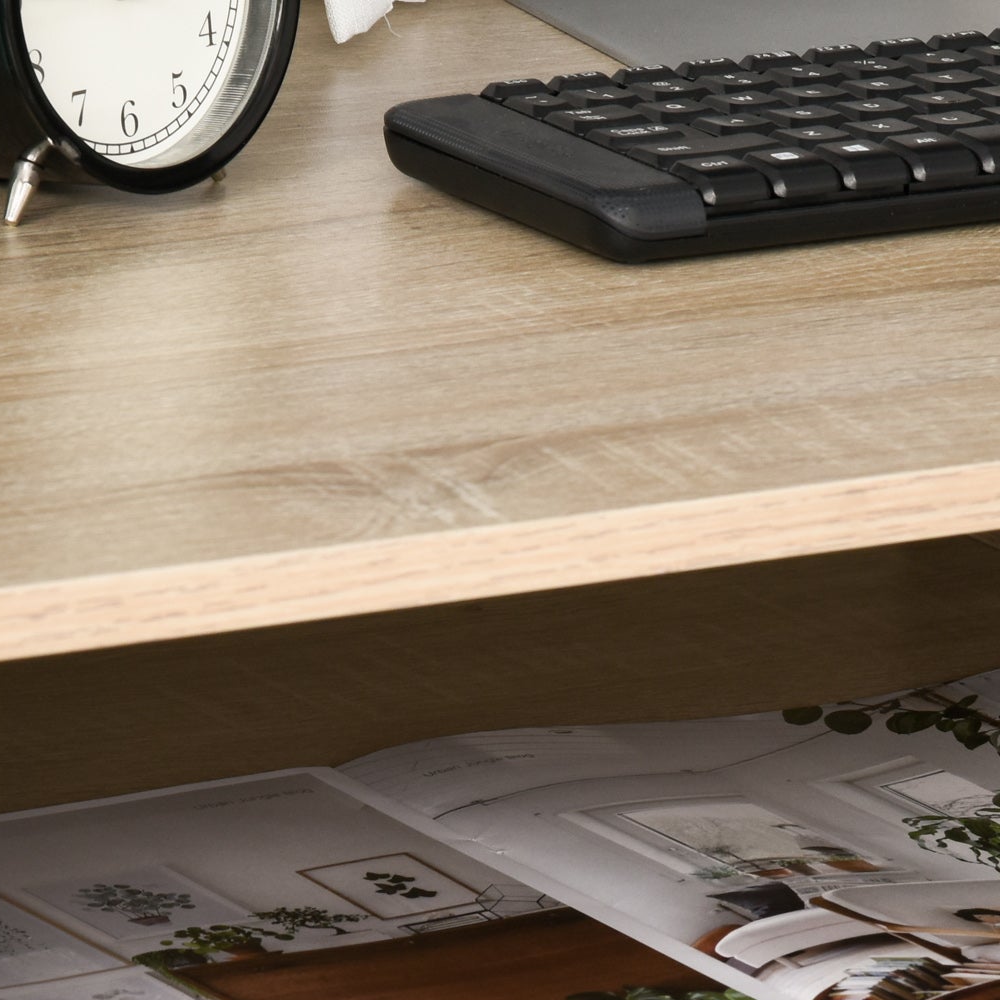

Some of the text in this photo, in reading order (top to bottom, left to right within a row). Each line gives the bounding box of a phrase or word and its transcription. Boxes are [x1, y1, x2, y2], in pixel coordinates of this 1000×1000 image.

[198, 10, 217, 47] 4
[71, 89, 87, 127] 7
[171, 70, 187, 109] 5
[120, 99, 139, 138] 6
